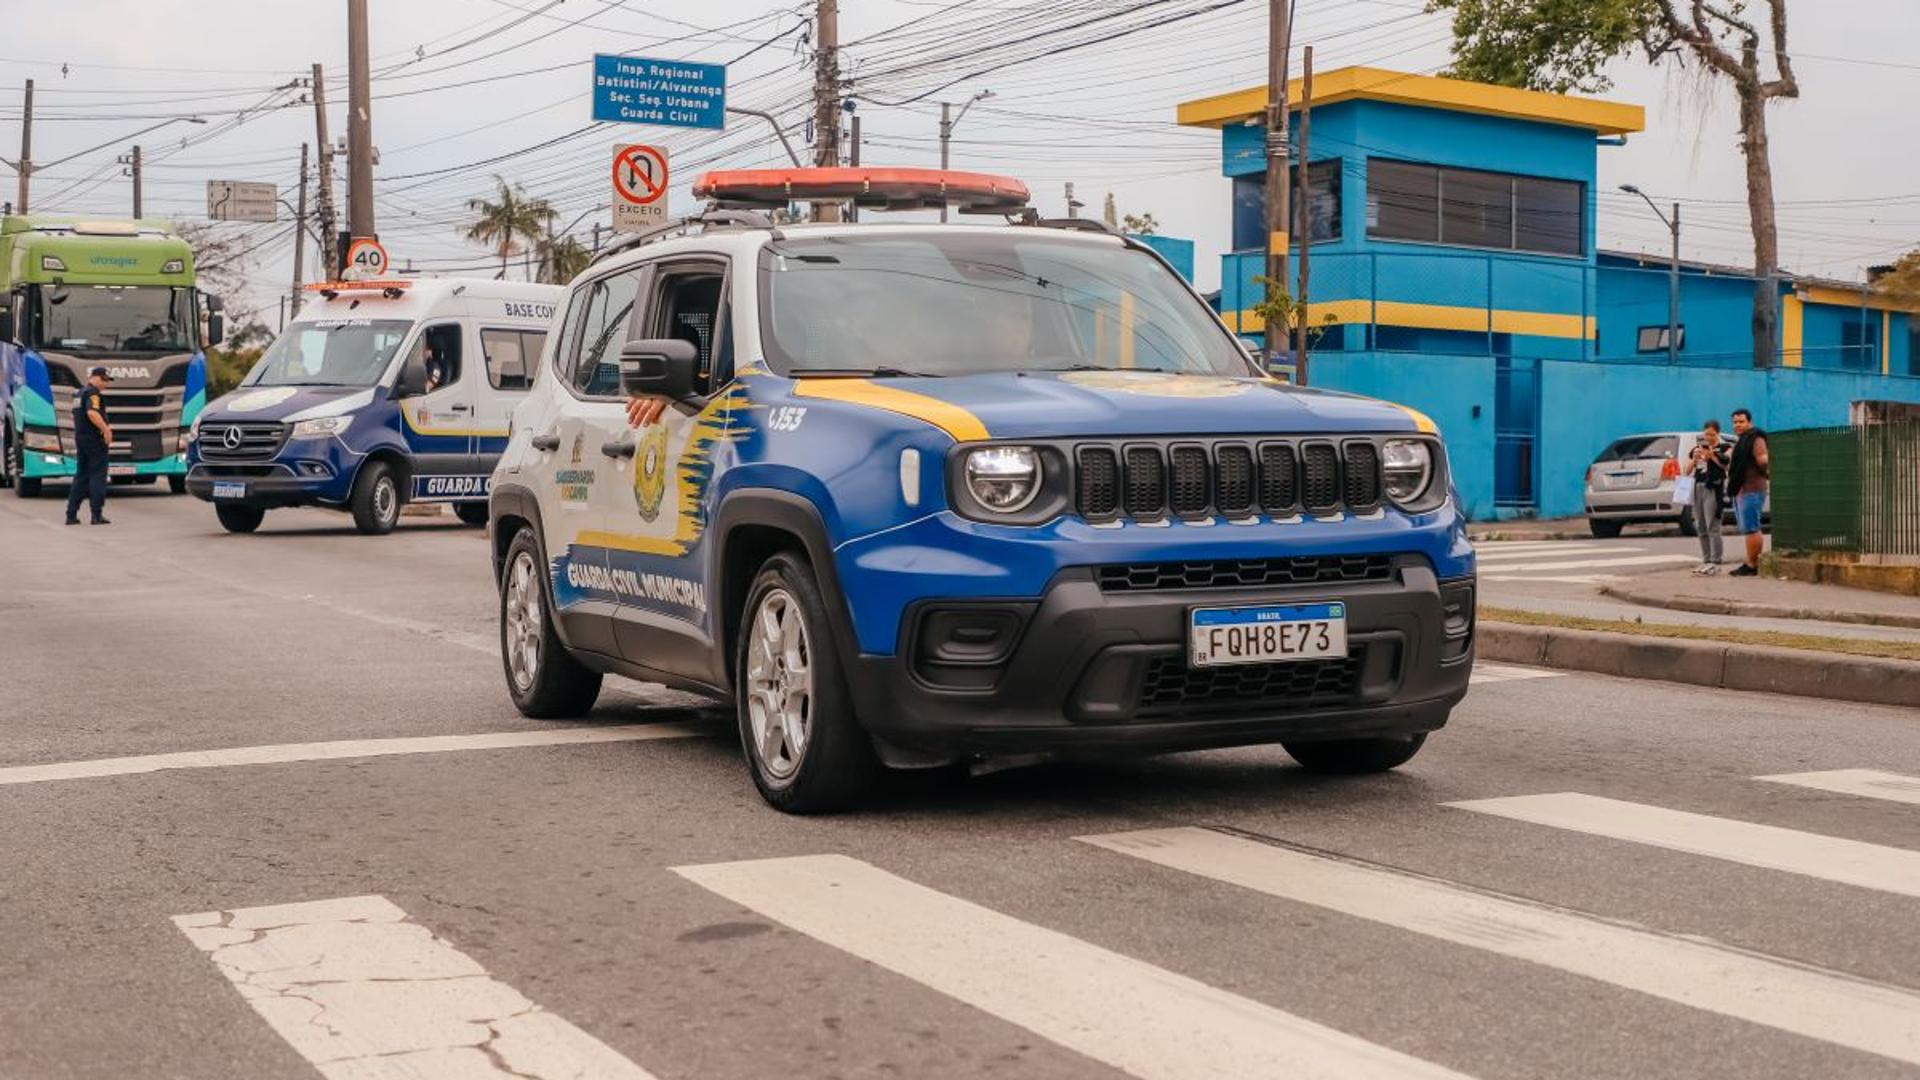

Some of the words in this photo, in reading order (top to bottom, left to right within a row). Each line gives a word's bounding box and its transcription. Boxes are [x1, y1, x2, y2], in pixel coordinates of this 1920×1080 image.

[617, 62, 646, 77] Insp.
[650, 64, 704, 80] Regional
[597, 75, 723, 97] Batistini/Alvarenga
[609, 91, 635, 104] Sec.
[638, 93, 663, 108] Seg.
[666, 96, 709, 110] Urbana
[620, 107, 664, 121] Guarda
[669, 111, 699, 123] Civil
[618, 204, 662, 216] EXCETO
[355, 250, 381, 266] 40
[505, 303, 534, 318] BASE
[428, 477, 482, 494] GUARDA
[568, 563, 614, 592] GUARDA
[611, 569, 644, 597] CIVIL
[642, 573, 707, 612] MUNICIPAL
[1209, 622, 1331, 658] FQH8E73
